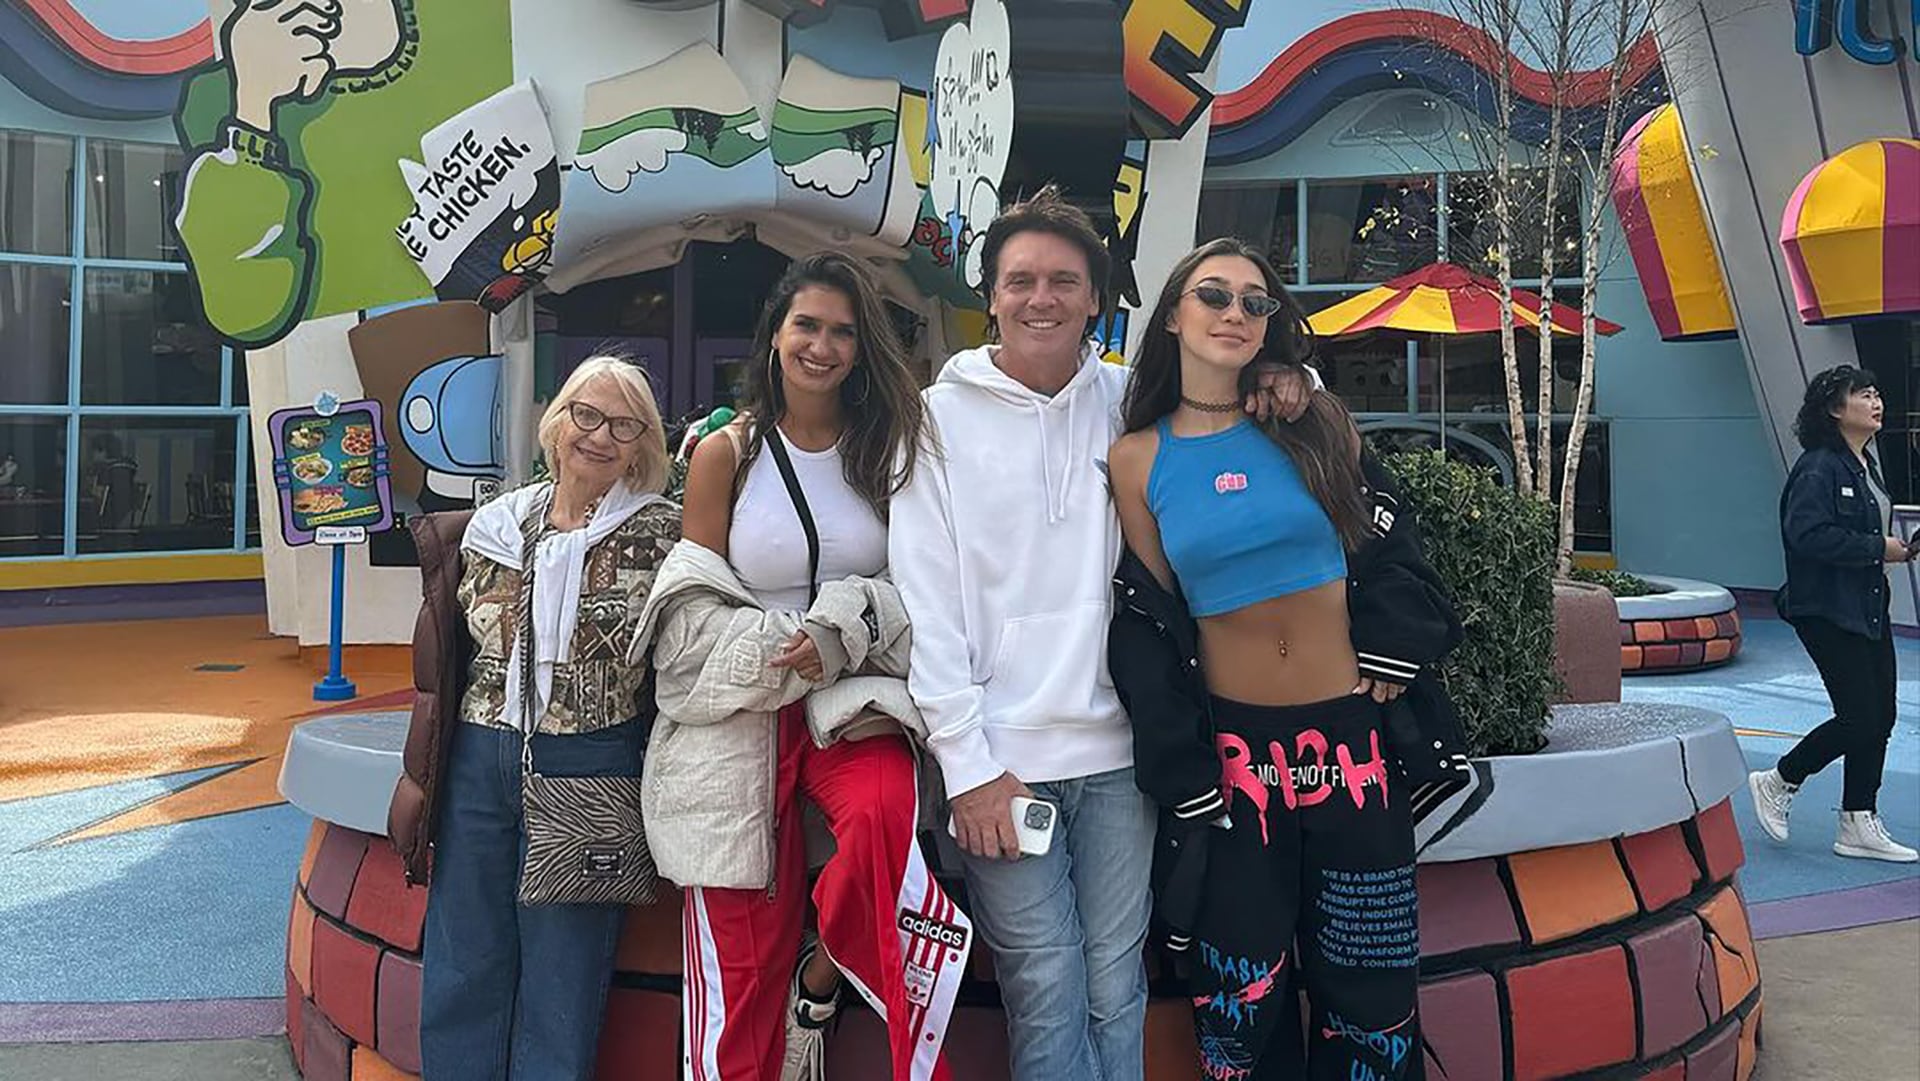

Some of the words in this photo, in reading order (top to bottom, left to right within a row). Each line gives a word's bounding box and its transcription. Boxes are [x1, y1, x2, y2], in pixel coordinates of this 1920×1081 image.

[418, 129, 463, 199] TASTE
[428, 136, 531, 241] CHICKEN.
[1357, 881, 1401, 895] CREATED
[1363, 870, 1397, 882] BRAND
[902, 916, 963, 946] adidas
[1200, 940, 1268, 986] TRASH
[1346, 945, 1411, 956] TRANSFORM
[1209, 990, 1258, 1031] ART
